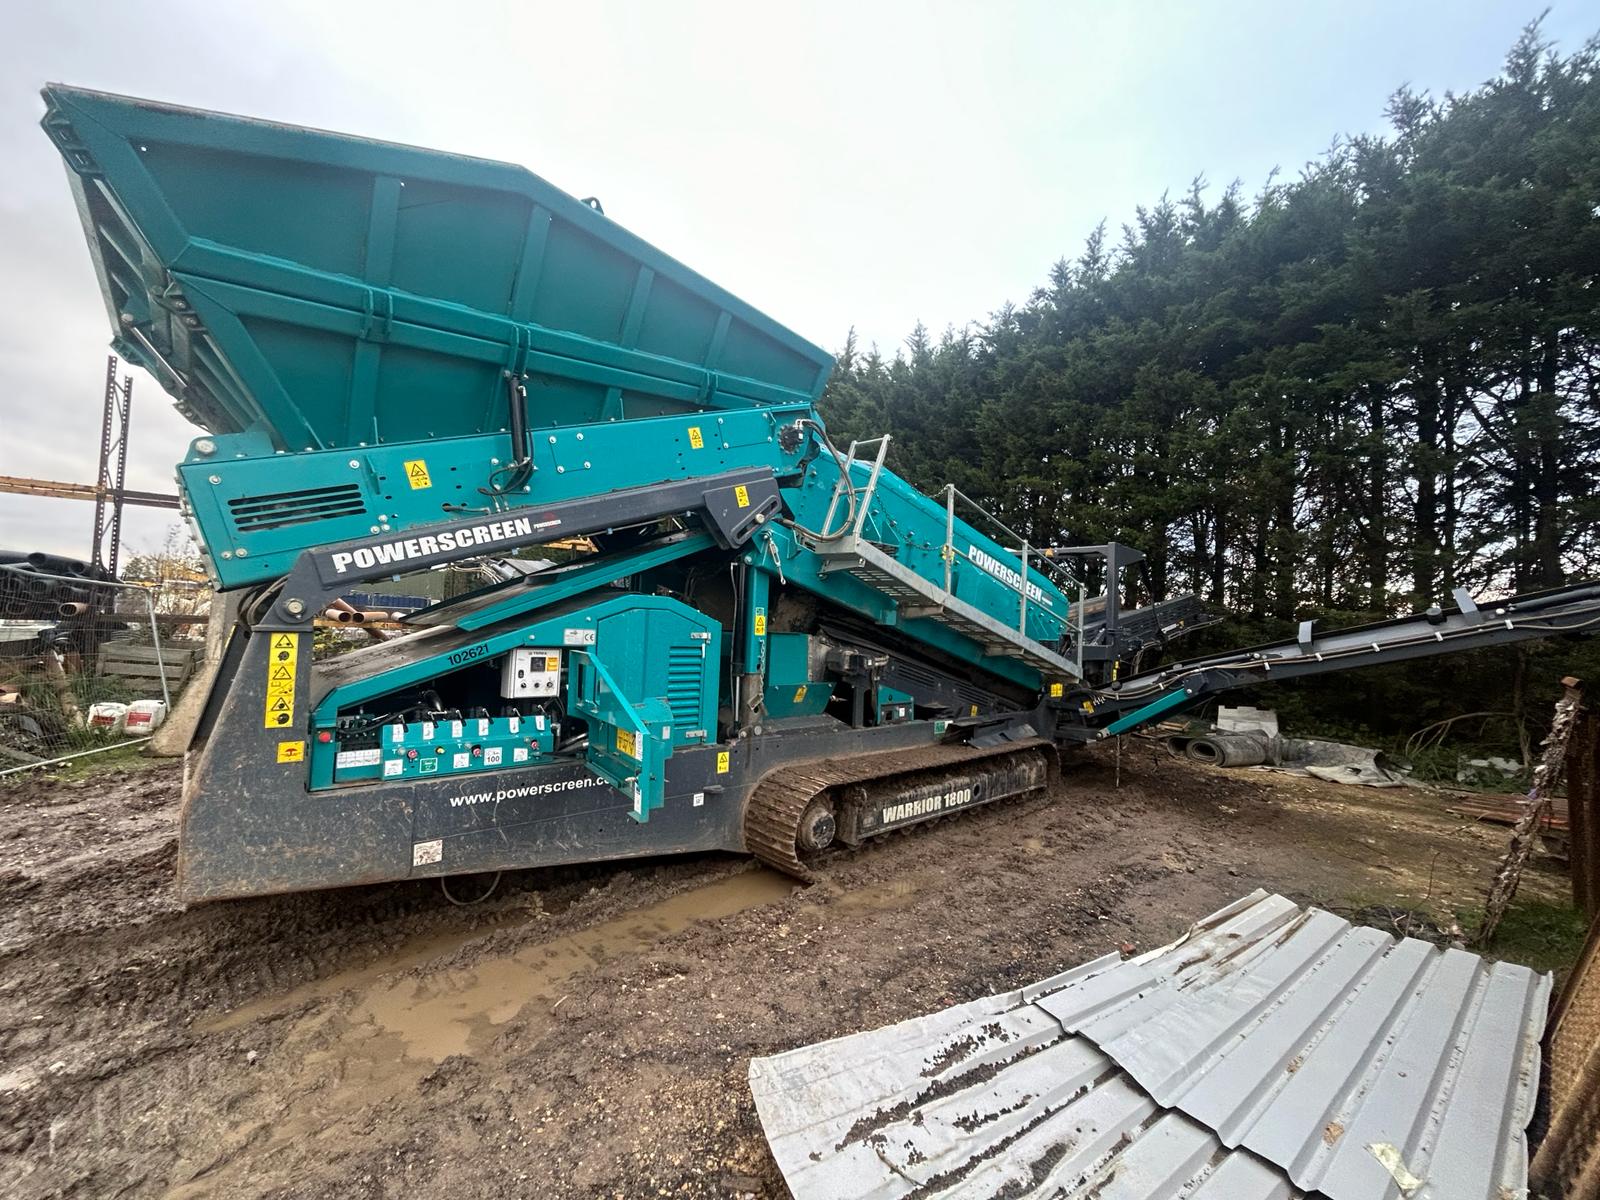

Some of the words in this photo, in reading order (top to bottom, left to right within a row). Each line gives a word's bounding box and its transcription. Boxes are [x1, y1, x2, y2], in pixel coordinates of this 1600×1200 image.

[331, 518, 532, 573] POWERSCREEN
[448, 644, 489, 666] 102621
[487, 755, 500, 763] 100
[882, 795, 942, 824] WARRIOR
[943, 788, 971, 808] 1800
